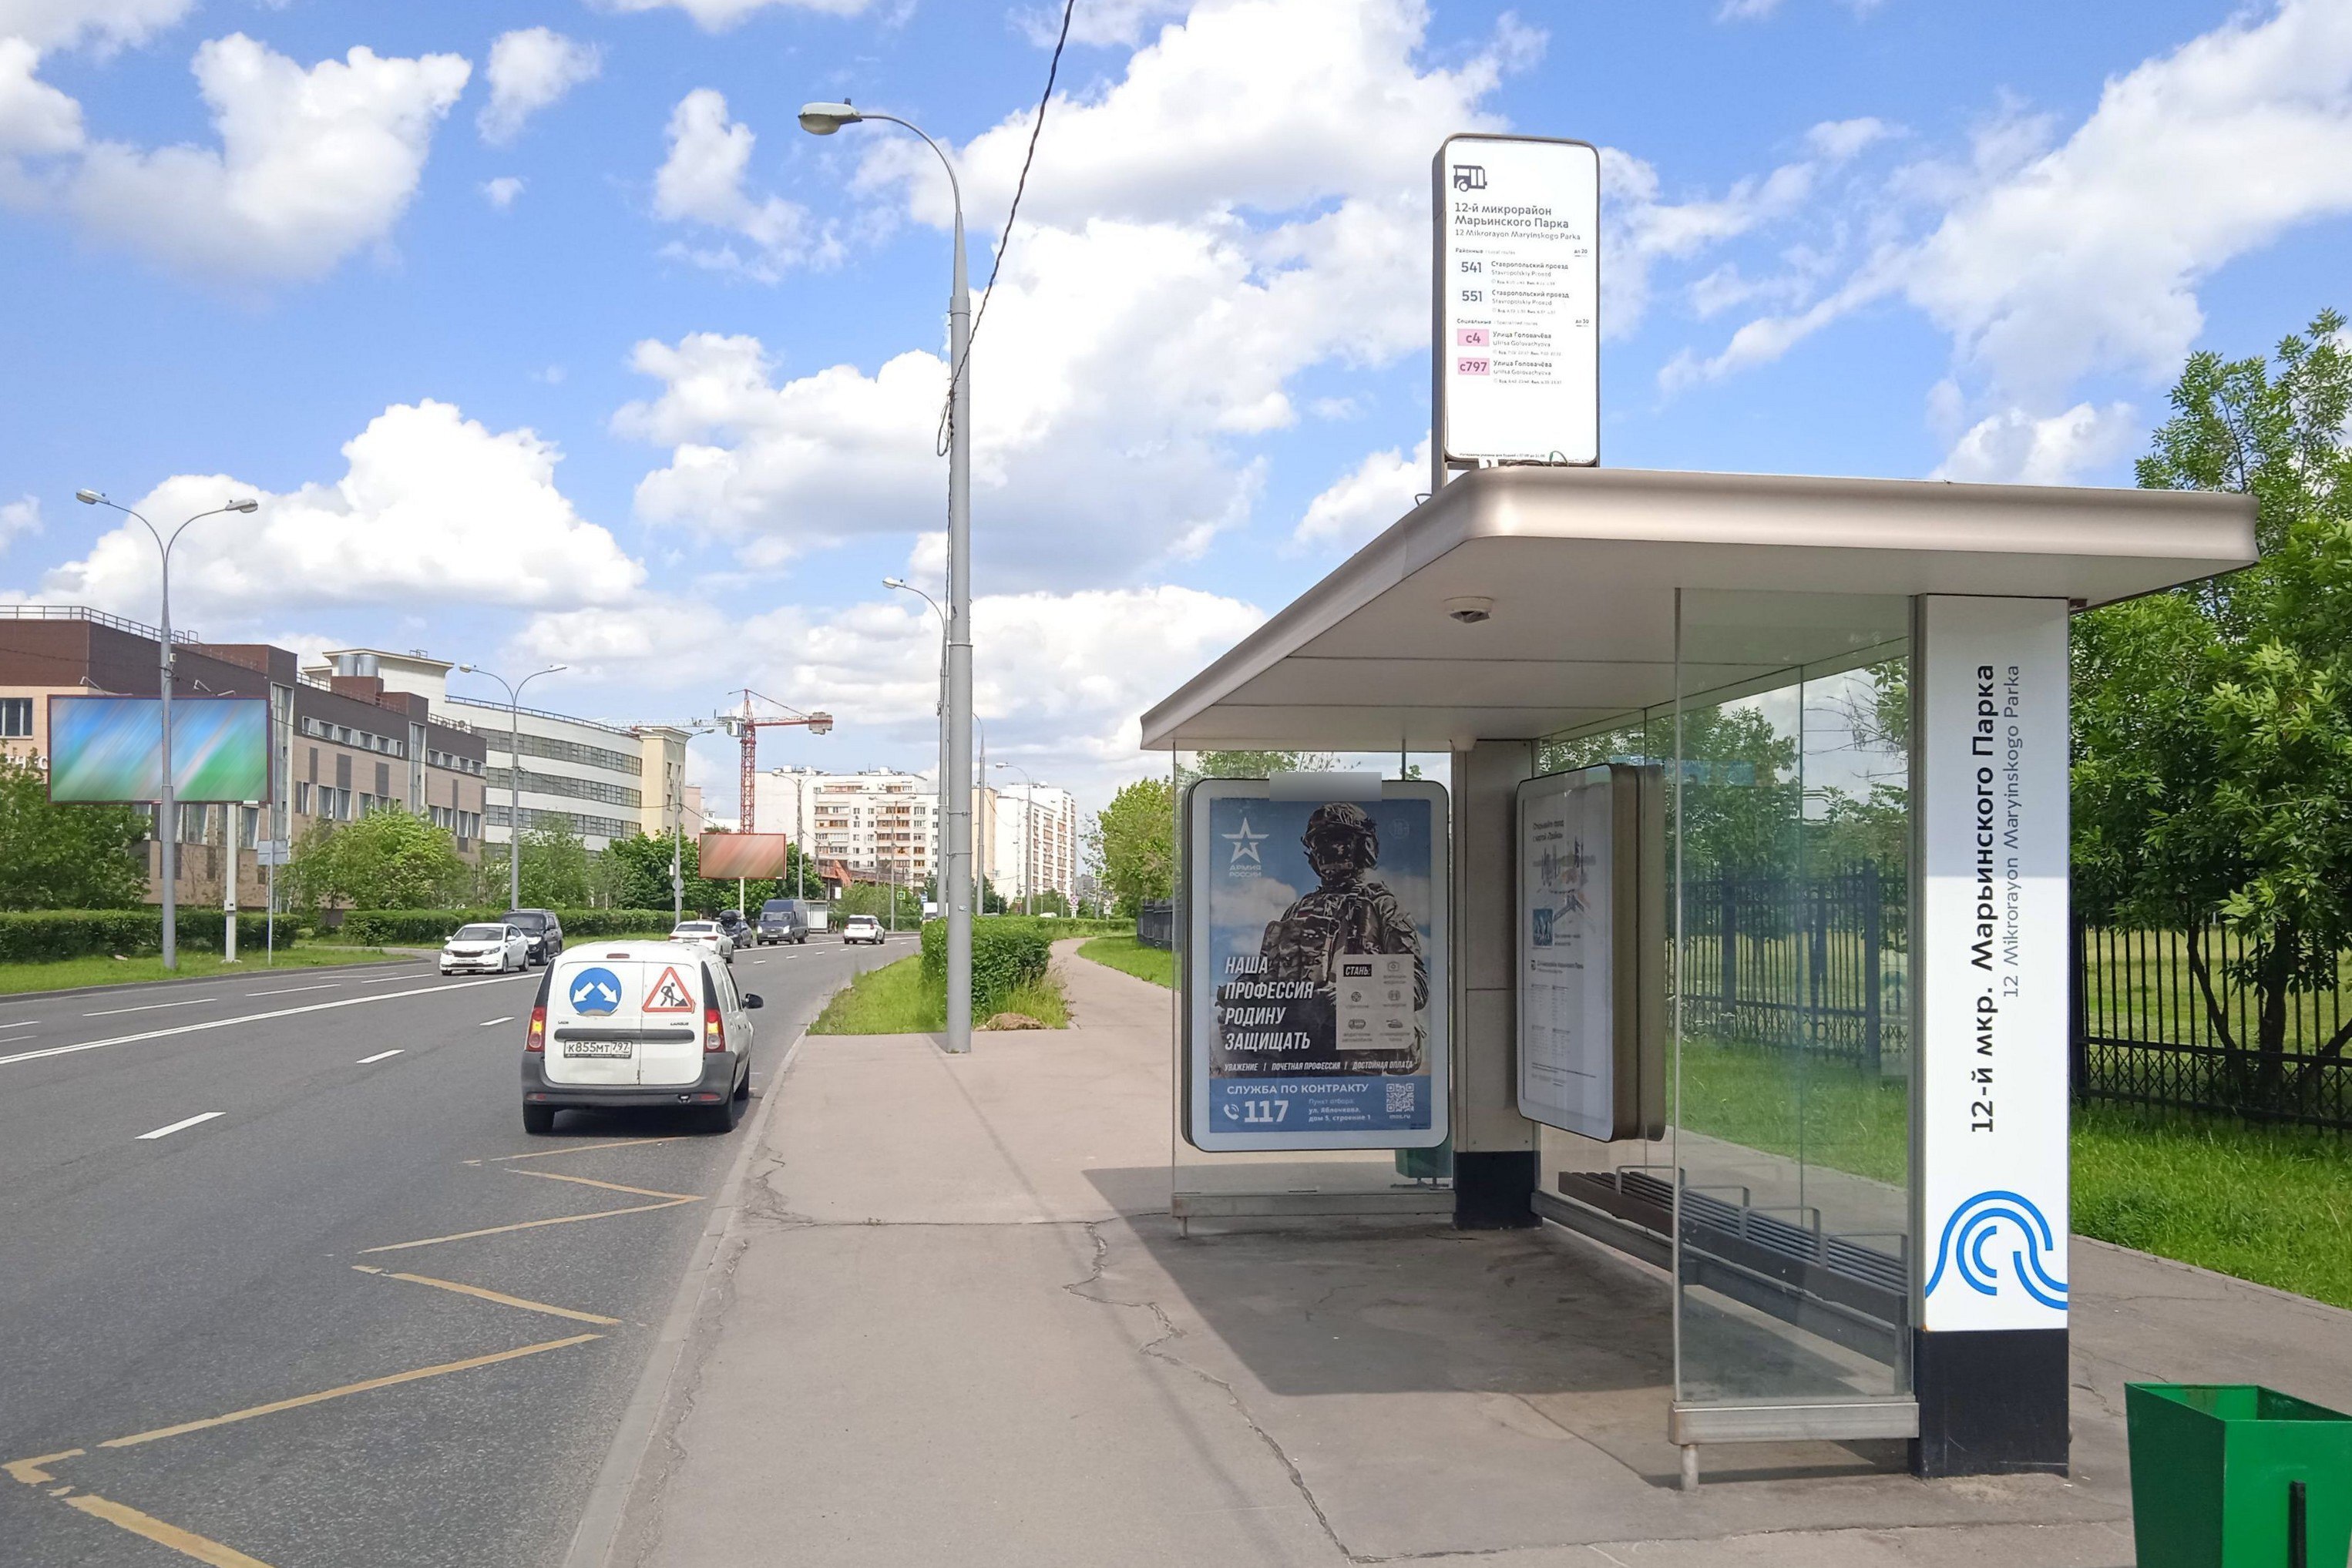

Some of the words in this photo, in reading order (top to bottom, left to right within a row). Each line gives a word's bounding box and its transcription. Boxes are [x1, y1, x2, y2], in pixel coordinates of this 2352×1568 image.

[1455, 202, 1478, 213] 12-й
[1481, 204, 1551, 216] микрорайон
[1455, 216, 1531, 227] Марьинского
[1534, 218, 1569, 230] Парка
[1466, 230, 1509, 240] Mikrorayon
[1510, 231, 1558, 241] Maryinskogo
[1461, 261, 1482, 273] 541
[1491, 260, 1544, 269] Ставропольский
[1462, 290, 1483, 302] 551
[2004, 666, 2019, 718] Parka
[1972, 665, 1998, 756] Парка
[2003, 725, 2023, 849] Maryinskogo
[1971, 767, 1998, 972] Марьинского
[2004, 858, 2022, 966] Mikrorayon
[1225, 956, 1268, 974] НАША
[1225, 981, 1314, 999] ПРОФЕССИЯ
[2004, 975, 2018, 997] 12
[1225, 1006, 1286, 1027] РОДИНУ
[1976, 987, 1998, 1056] мкр.
[613, 1042, 628, 1051] 797
[1225, 1032, 1311, 1052] ЗАЩИЩАТЬ
[1272, 1063, 1304, 1071] ПОЧЕТНАЯ
[1304, 1062, 1341, 1070] ПРОФЕССИЯ
[1352, 1060, 1388, 1070] ДОСТОЙНАЯ
[1389, 1060, 1413, 1069] ОПЛАТА
[1227, 1085, 1278, 1094] СЛУЖБА
[1281, 1085, 1298, 1094] ПО
[1302, 1084, 1369, 1093] КОНТРАКТУ
[1971, 1068, 1994, 1133] 12-й
[1244, 1100, 1289, 1123] 117
